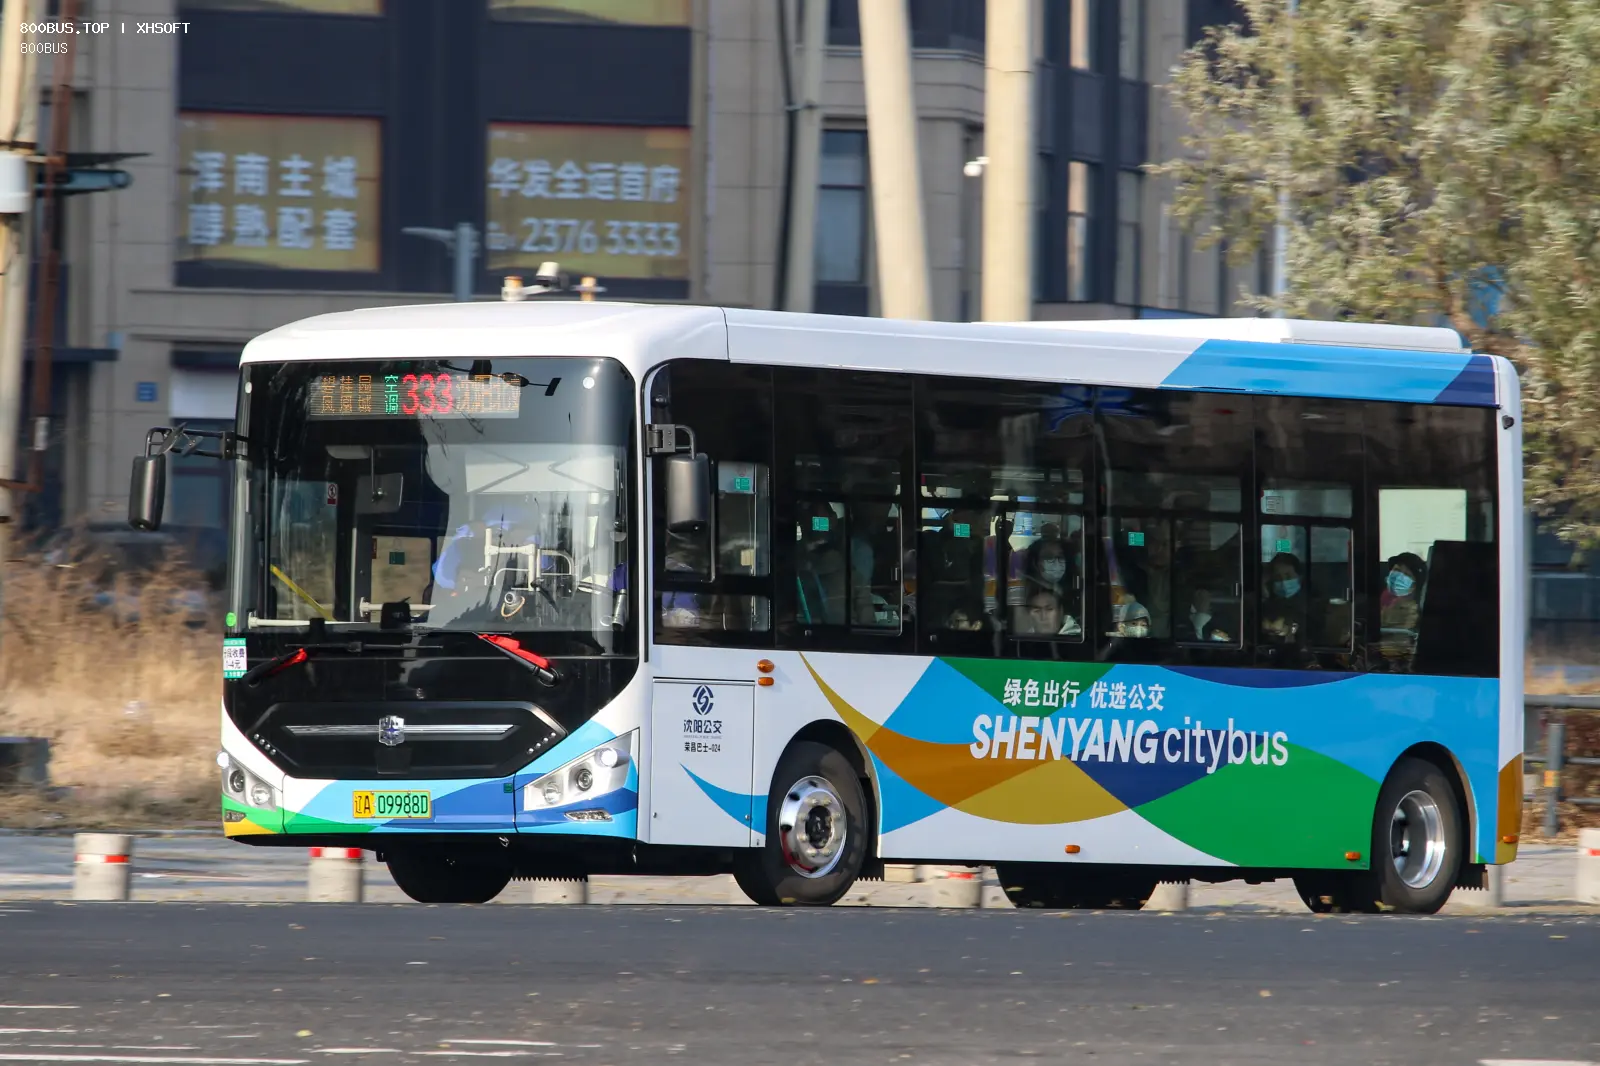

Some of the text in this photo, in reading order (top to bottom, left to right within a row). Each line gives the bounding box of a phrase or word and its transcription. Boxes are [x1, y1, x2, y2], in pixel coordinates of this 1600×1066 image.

[488, 158, 680, 203] 华发全运首府
[604, 221, 681, 256] 3333
[402, 374, 453, 415] 333
[1003, 678, 1166, 711] 绿色出行 优选公交
[683, 719, 722, 734] 沈阳公交
[970, 714, 1289, 774] SHENYANG citybus
